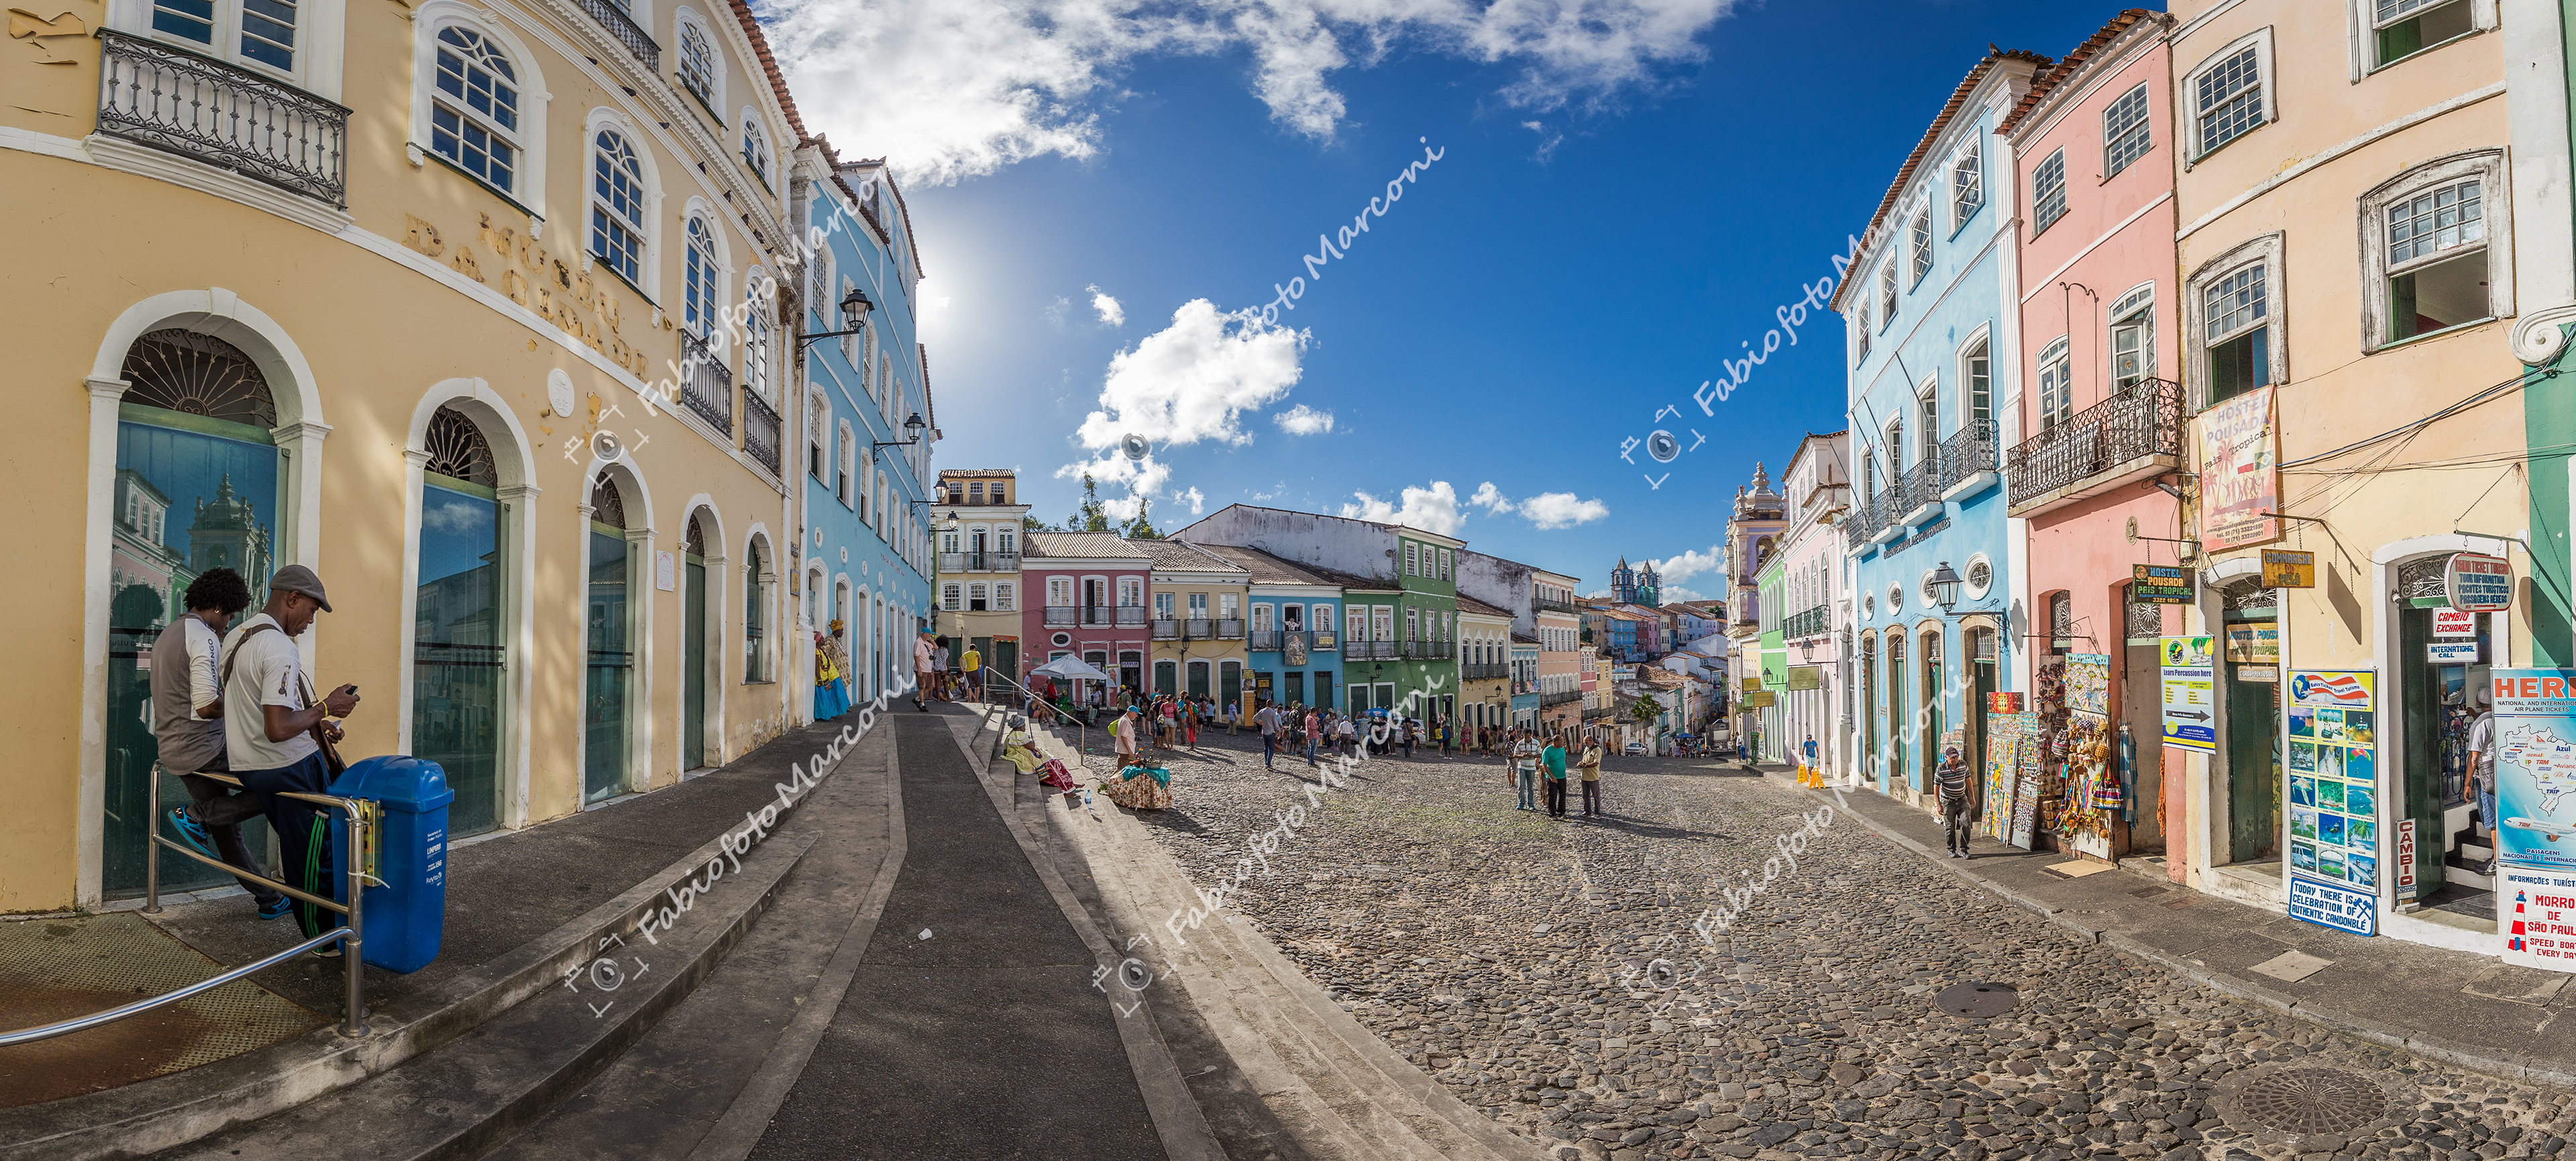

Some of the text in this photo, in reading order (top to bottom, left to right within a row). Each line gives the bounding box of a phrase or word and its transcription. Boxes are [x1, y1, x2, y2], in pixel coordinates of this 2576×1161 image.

[477, 211, 619, 334] MUSEU
[402, 213, 649, 383] DA CIDADE
[2217, 394, 2268, 424] HOSTEL
[2206, 412, 2270, 446] POUSADA
[2229, 426, 2273, 455] Tropical
[2241, 523, 2263, 532] 33221859
[2241, 530, 2263, 540] 33229901
[2265, 552, 2312, 565] COMMANCHE
[2150, 567, 2181, 577] HOSTEL
[2286, 564, 2294, 574] DO
[2456, 560, 2509, 575] BAHIA TICKET TURISMO
[2148, 576, 2184, 587] POUSADA
[2459, 573, 2505, 584] TOUR INFORMATION
[2159, 587, 2192, 595] TROPICAL
[2459, 585, 2481, 594] PACOTES
[2460, 595, 2489, 604] PASSAGENS
[2438, 612, 2469, 621] CAMBIO
[2436, 624, 2473, 632] EXCHANGE
[2229, 631, 2255, 640] HOSTEL
[2321, 683, 2332, 691] Ticket
[427, 843, 441, 854] LIMPURB
[2400, 821, 2413, 887] CAMBIO
[2508, 874, 2549, 885] INFORMAÇÕES
[2295, 883, 2353, 904] TODAY THERE IS
[2293, 895, 2357, 916] CELEBRATION OF
[2536, 895, 2575, 909] MORRO
[2292, 904, 2366, 931] AUTHENTIC CANDONBLÉ
[2548, 911, 2561, 921] DE
[2528, 921, 2547, 933] SÃO
[2530, 938, 2555, 947] SPEED
[2537, 949, 2560, 958] EVERY
